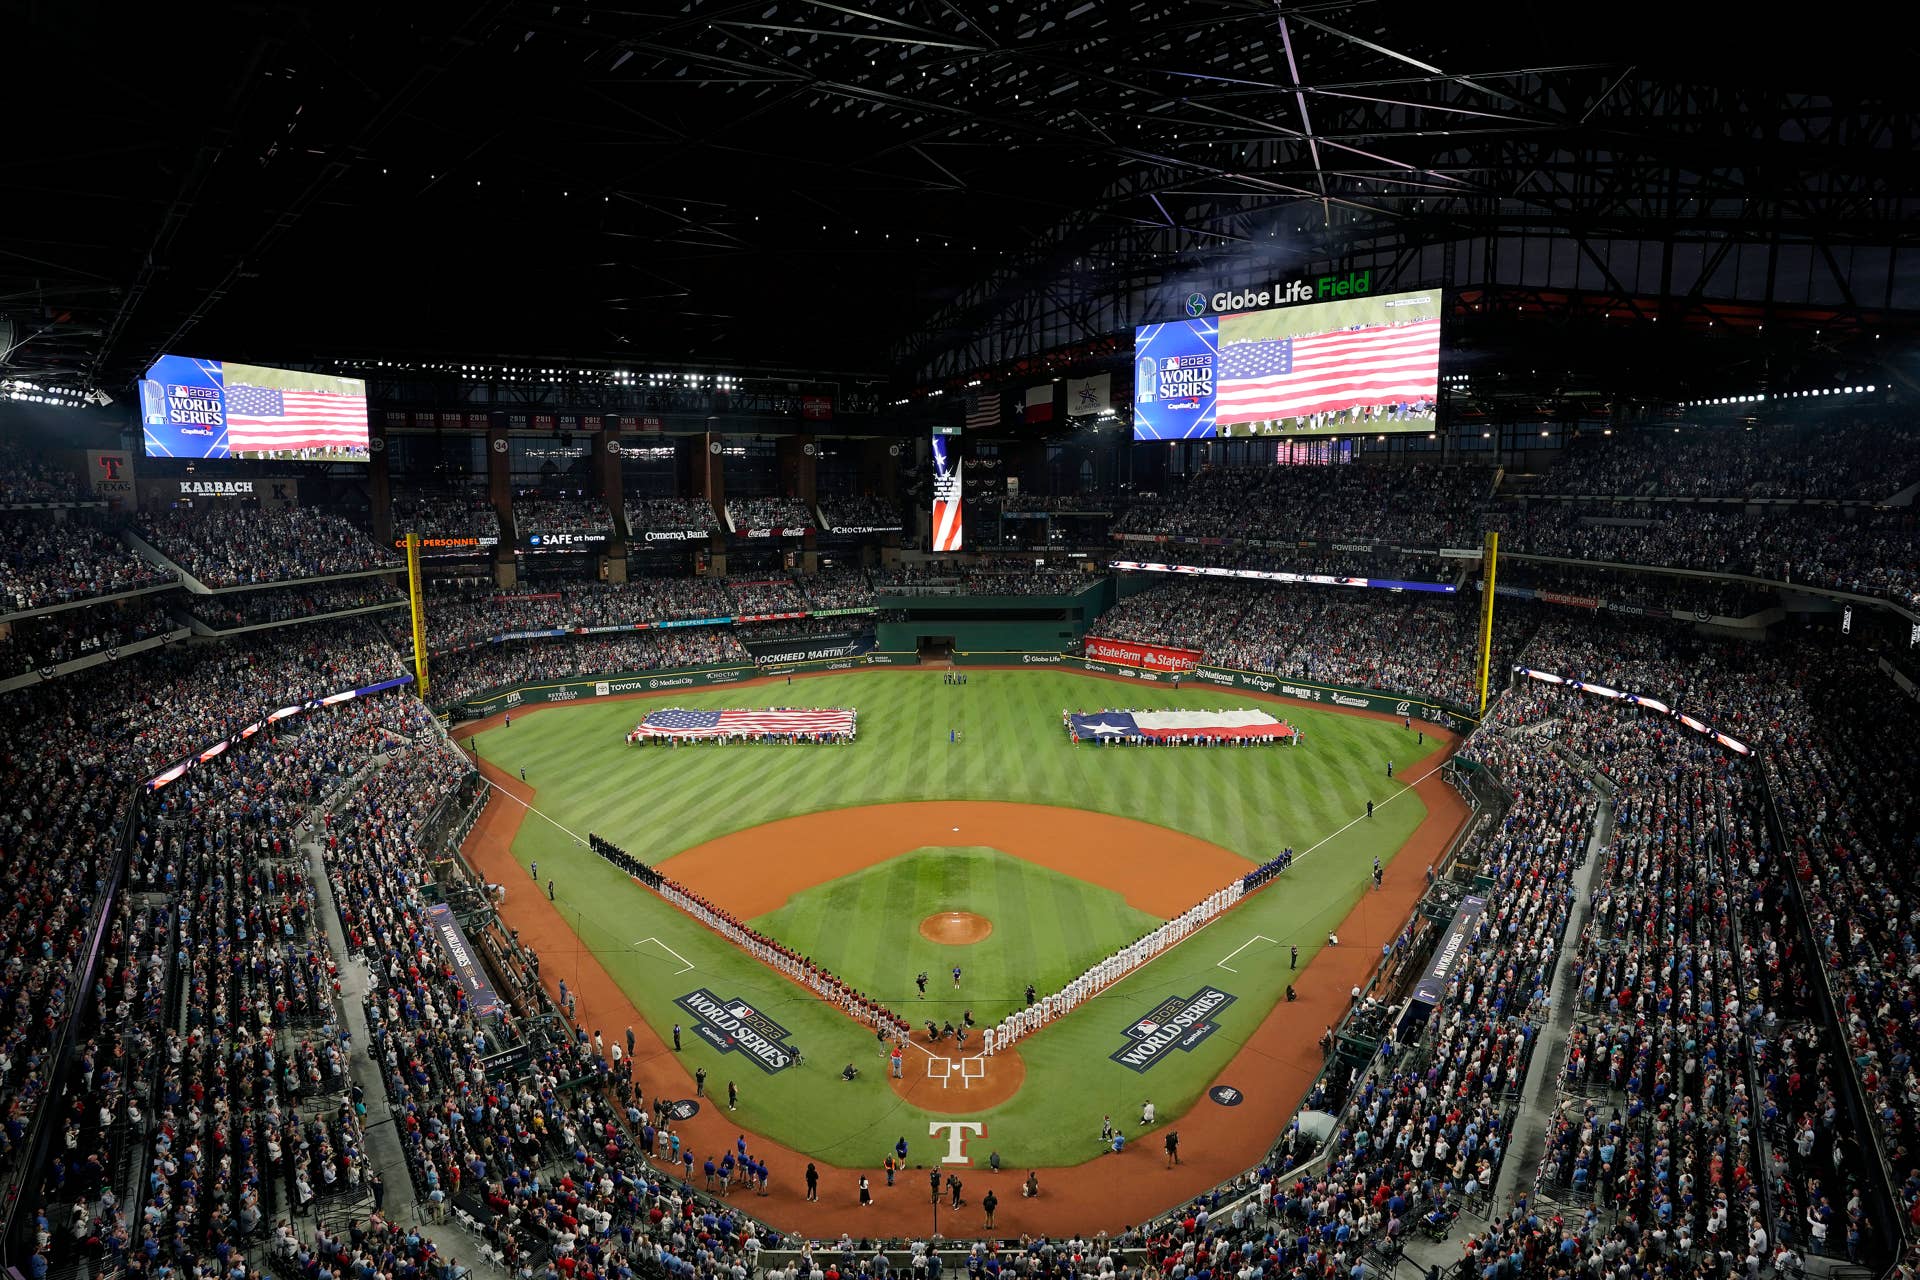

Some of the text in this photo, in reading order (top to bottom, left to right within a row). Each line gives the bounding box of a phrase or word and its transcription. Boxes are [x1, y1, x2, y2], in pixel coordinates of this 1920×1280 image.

[1211, 271, 1370, 312] Globe Life Field
[1180, 356, 1212, 367] 2023
[1160, 367, 1213, 384] WORLD
[189, 388, 220, 398] 2023
[1160, 381, 1213, 399] SERIES
[168, 397, 222, 412] WORLD
[170, 409, 224, 425] SERIES
[535, 415, 551, 423] 2011
[495, 442, 506, 450] 34
[98, 456, 124, 480] T
[96, 483, 131, 491] TEXAS
[180, 481, 253, 493] KARBACH
[687, 530, 709, 539] Bank
[837, 526, 873, 534] CHOCTAW
[424, 538, 479, 546] PERSONNEL
[543, 535, 572, 545] SAFE
[819, 609, 841, 617] LUXOR
[808, 648, 844, 659] MARTIN
[1098, 645, 1141, 661] State Farm
[1157, 654, 1181, 667] State
[706, 671, 739, 679] CHOCTAW
[1205, 671, 1235, 682] National
[610, 682, 641, 691] TOYOTA
[1251, 675, 1276, 692] Kroger
[507, 691, 521, 703] UTA
[1151, 1000, 1186, 1023] 2023
[686, 992, 790, 1069] WORLD SERIES
[747, 1015, 782, 1041] 2023
[1120, 990, 1226, 1066] WORLD SERIES
[494, 1055, 512, 1067] MLB
[928, 1121, 989, 1167] T
